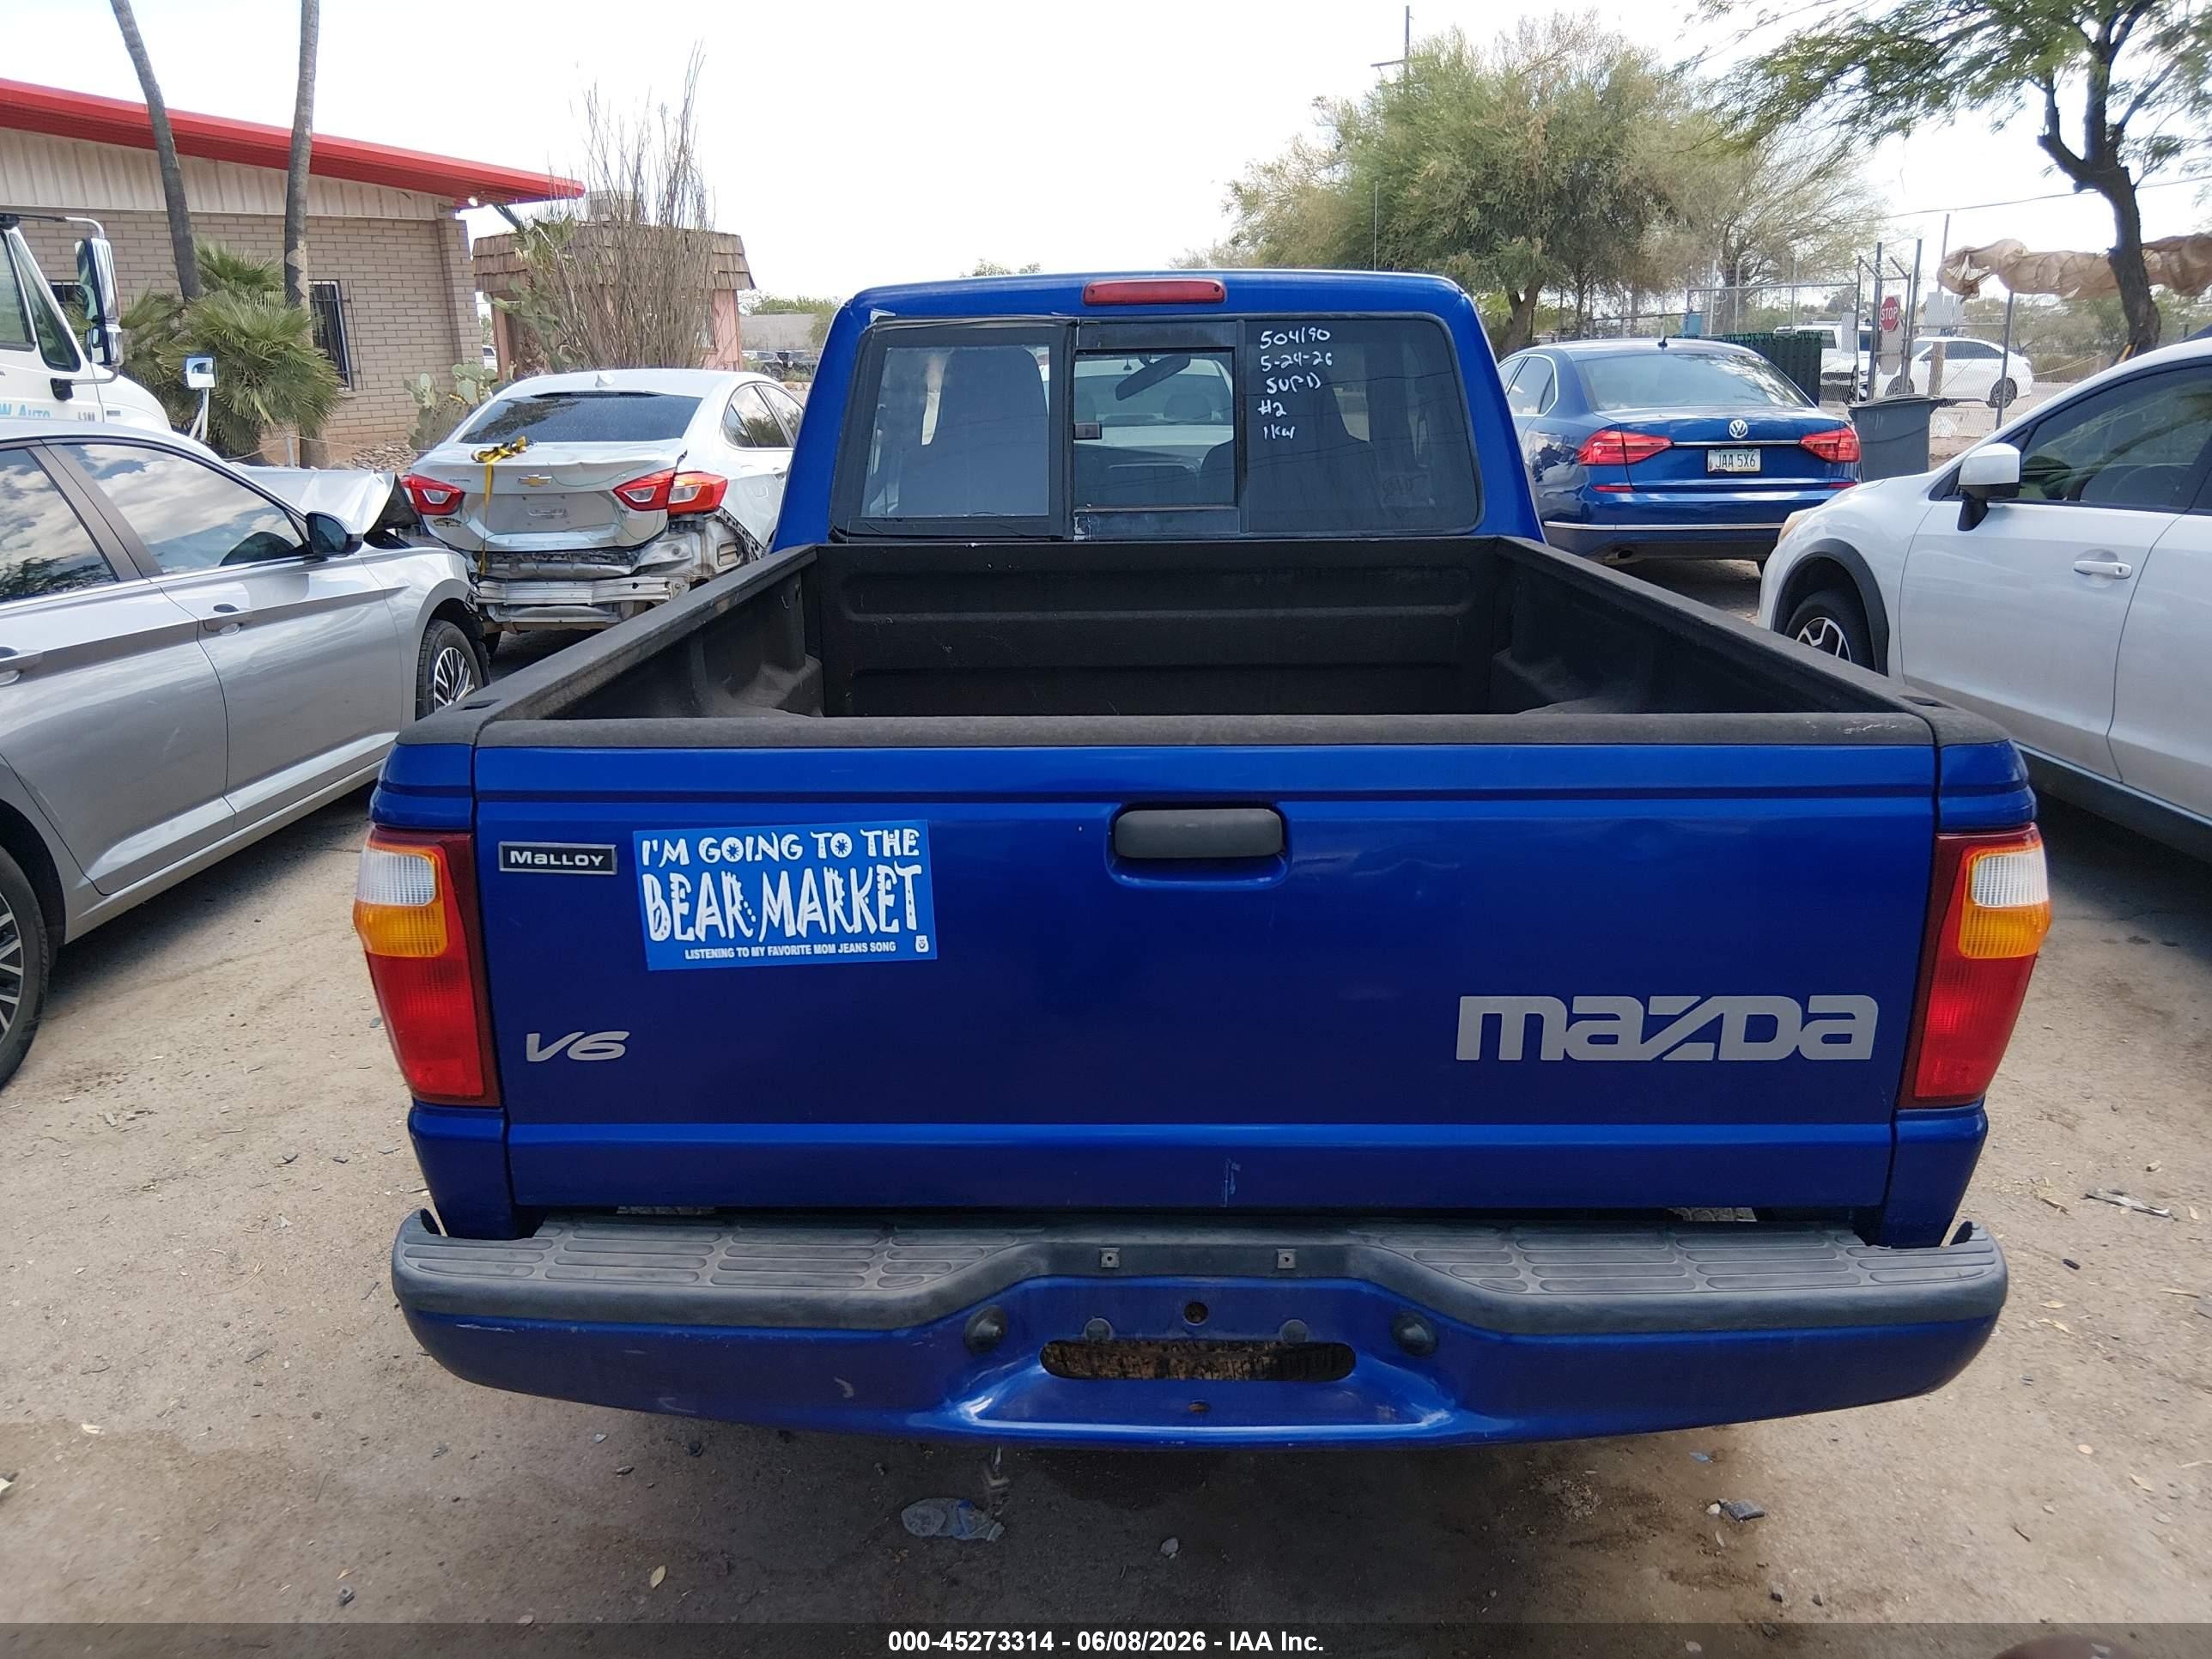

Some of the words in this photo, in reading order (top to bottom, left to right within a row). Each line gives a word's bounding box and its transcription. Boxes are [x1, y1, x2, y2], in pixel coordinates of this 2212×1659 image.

[1881, 307, 1898, 320] STOP
[1259, 326, 1331, 349] 504190
[1260, 350, 1333, 372] 5-24-26
[1257, 399, 1287, 417] #2
[1716, 453, 1734, 468] JAA
[1737, 453, 1756, 468] 5X6
[642, 838, 690, 868] I'M
[698, 831, 804, 864] GOING
[810, 831, 853, 859] TO
[860, 828, 921, 858] THE
[642, 870, 757, 943] BEAR
[758, 860, 923, 943] MARKET
[684, 947, 735, 960] LISTENING
[736, 947, 750, 958] TO
[751, 946, 766, 957] MY
[768, 945, 812, 956] FAVORITE
[814, 944, 836, 955] MOM
[838, 943, 868, 954] JEANS
[870, 942, 896, 952] SONG
[526, 1030, 630, 1062] V6
